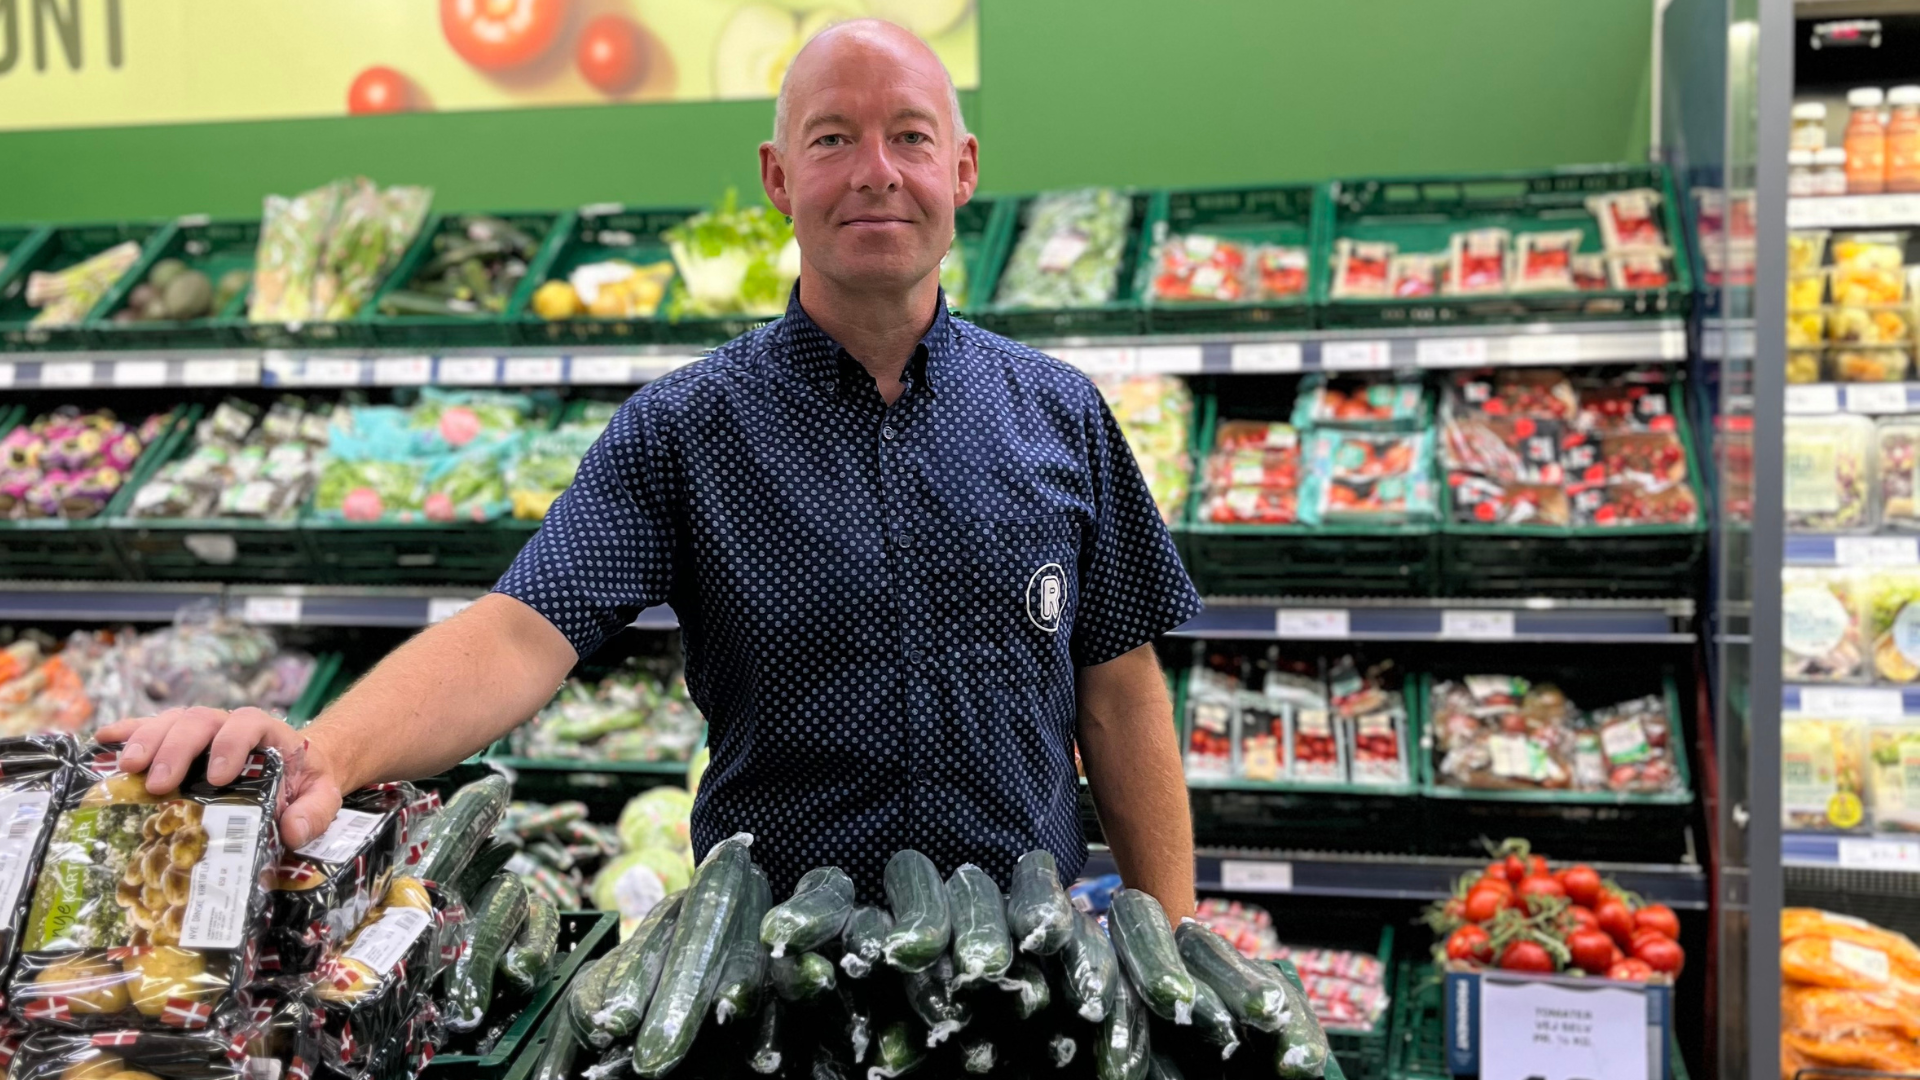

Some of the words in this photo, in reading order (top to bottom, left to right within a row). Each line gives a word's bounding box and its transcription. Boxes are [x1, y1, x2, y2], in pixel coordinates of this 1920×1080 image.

[1041, 575, 1060, 620] R
[51, 903, 77, 938] nye
[189, 925, 199, 940] NYE
